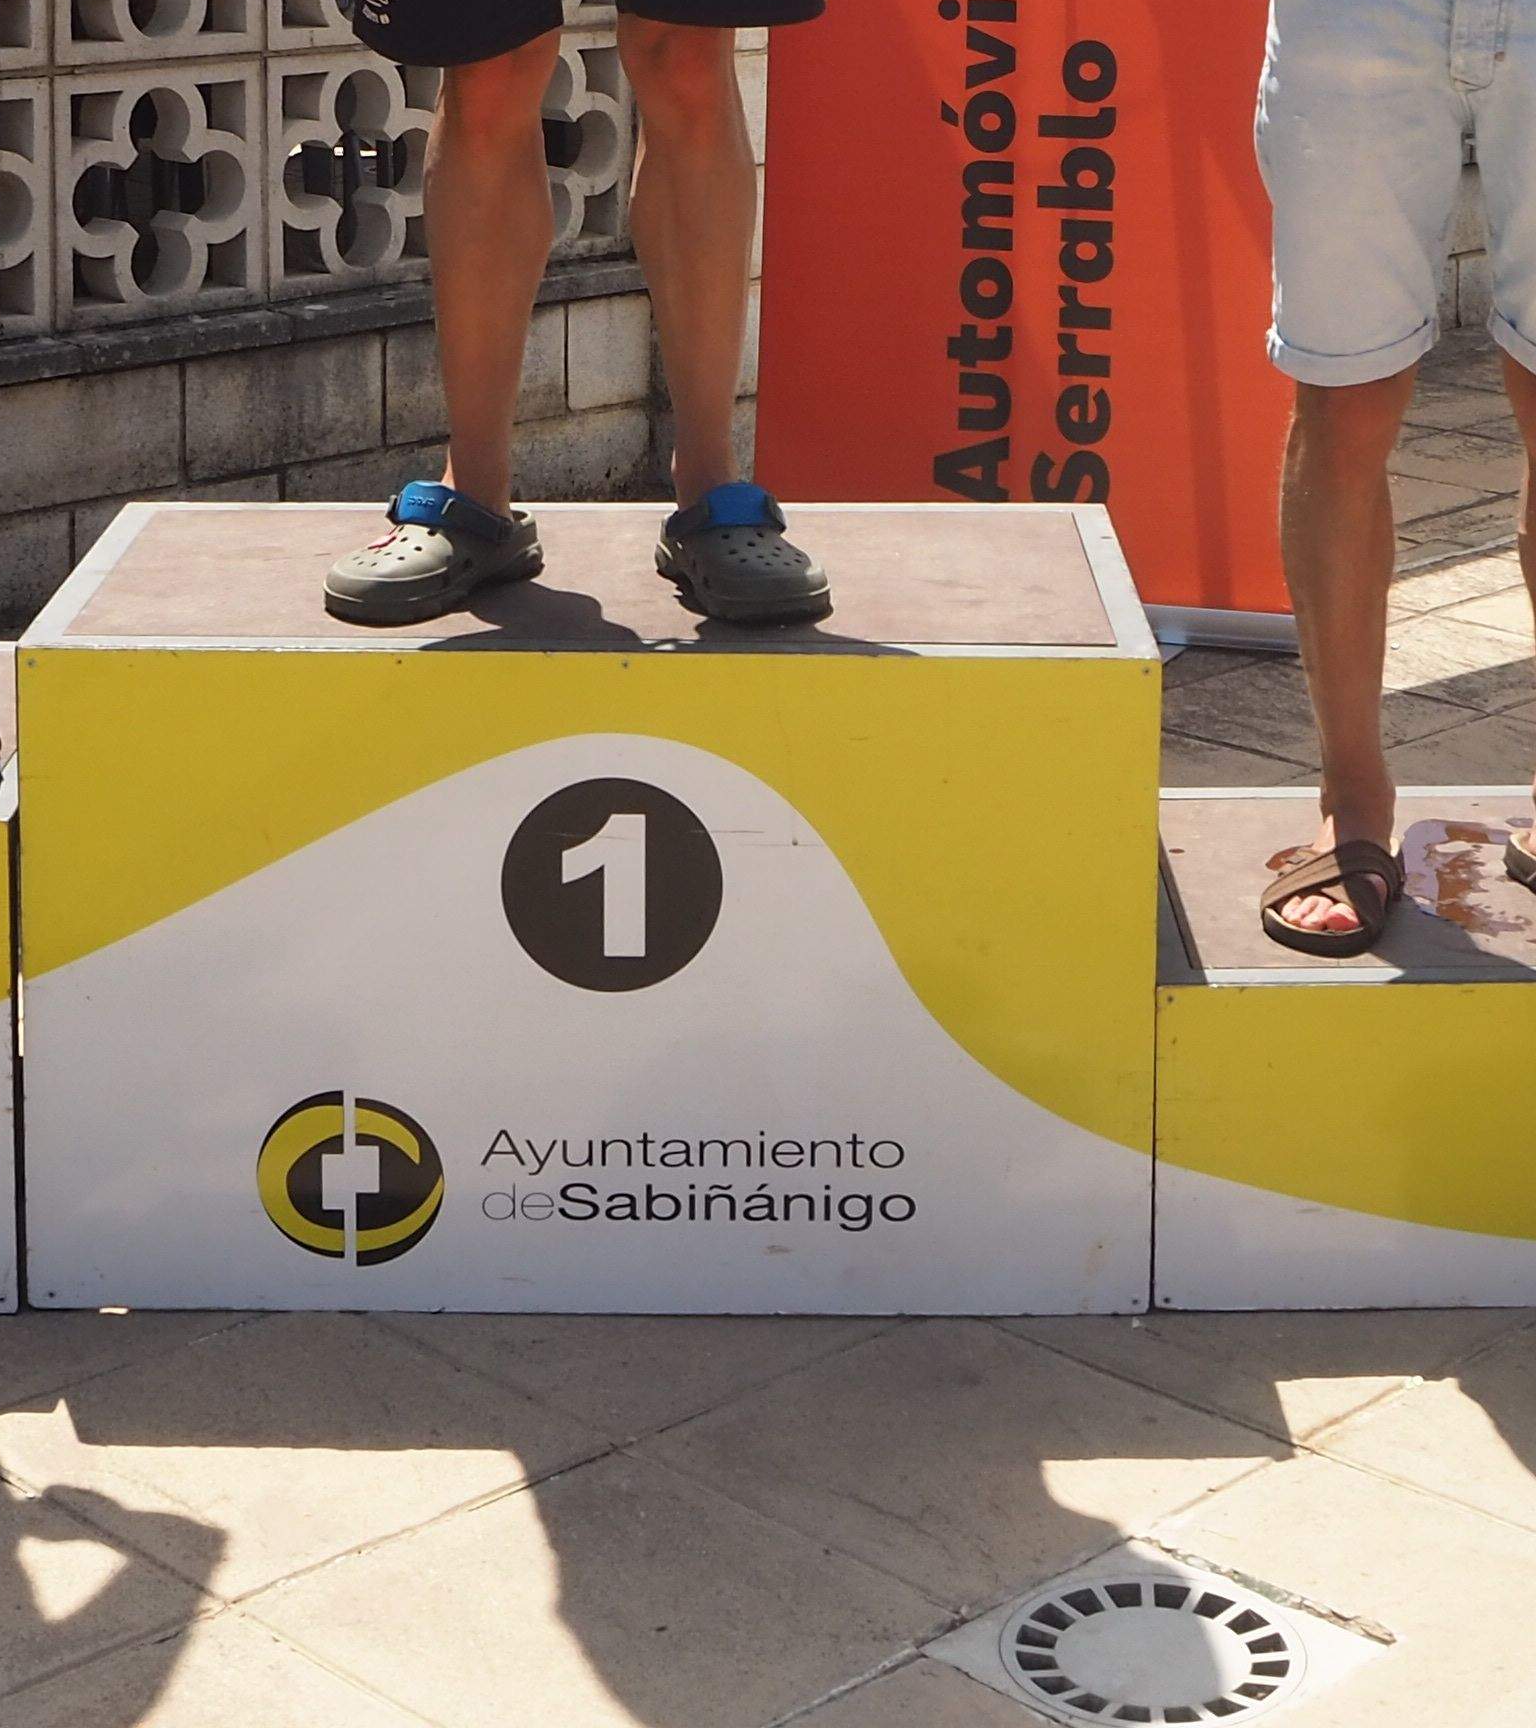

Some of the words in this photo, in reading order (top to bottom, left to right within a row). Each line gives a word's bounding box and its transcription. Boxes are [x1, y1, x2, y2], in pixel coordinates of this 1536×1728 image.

[1030, 39, 1118, 503] Serrablo
[562, 813, 646, 957] 1
[481, 1129, 905, 1175] Ayuntamiento
[481, 1182, 917, 1232] deSabiñánigo
